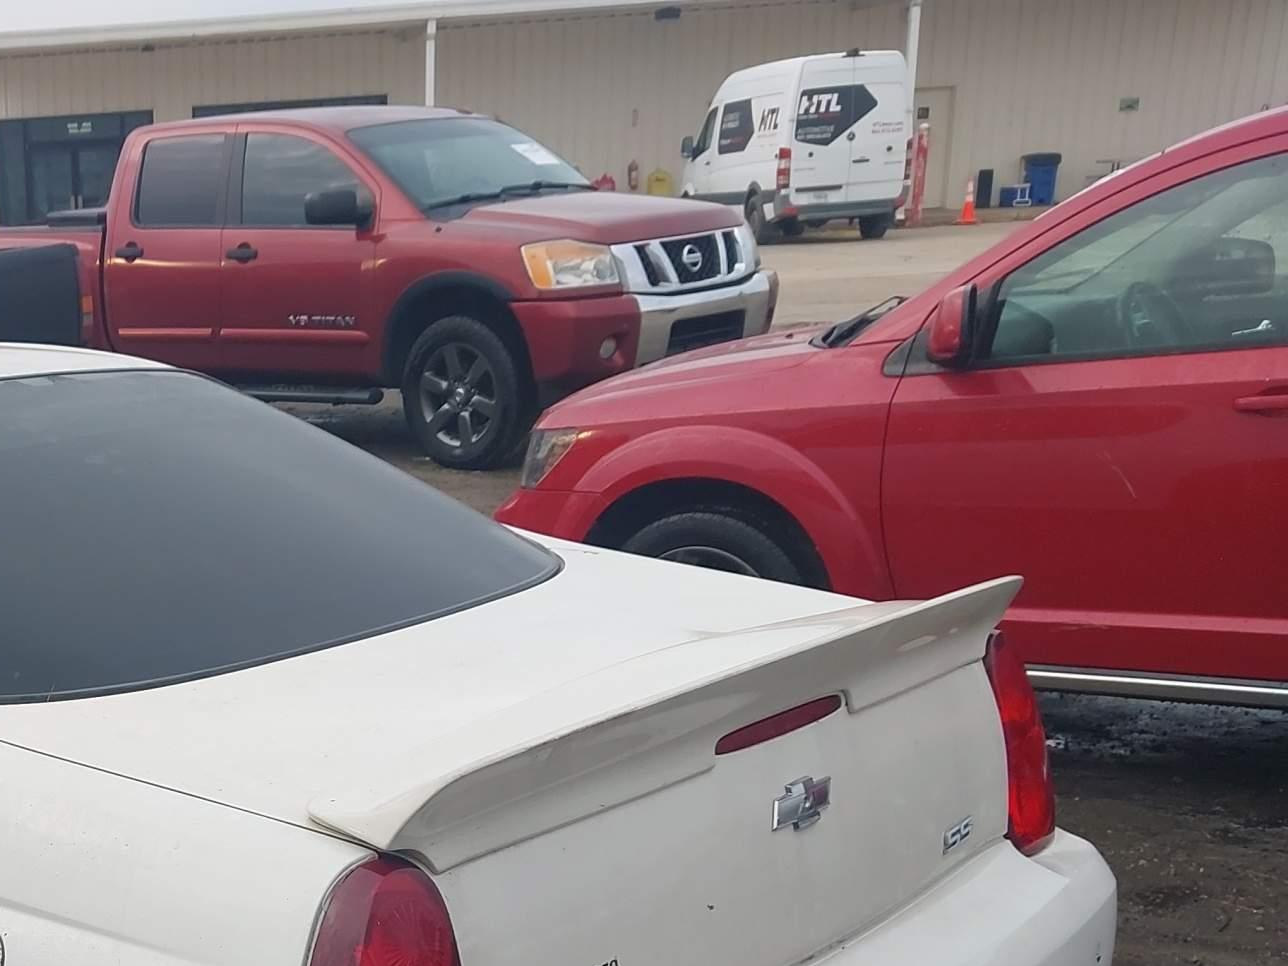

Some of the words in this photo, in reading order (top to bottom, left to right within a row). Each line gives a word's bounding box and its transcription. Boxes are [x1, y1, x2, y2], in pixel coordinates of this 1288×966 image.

[799, 93, 841, 114] HTL
[759, 107, 779, 131] HTL
[311, 314, 355, 327] TITAN
